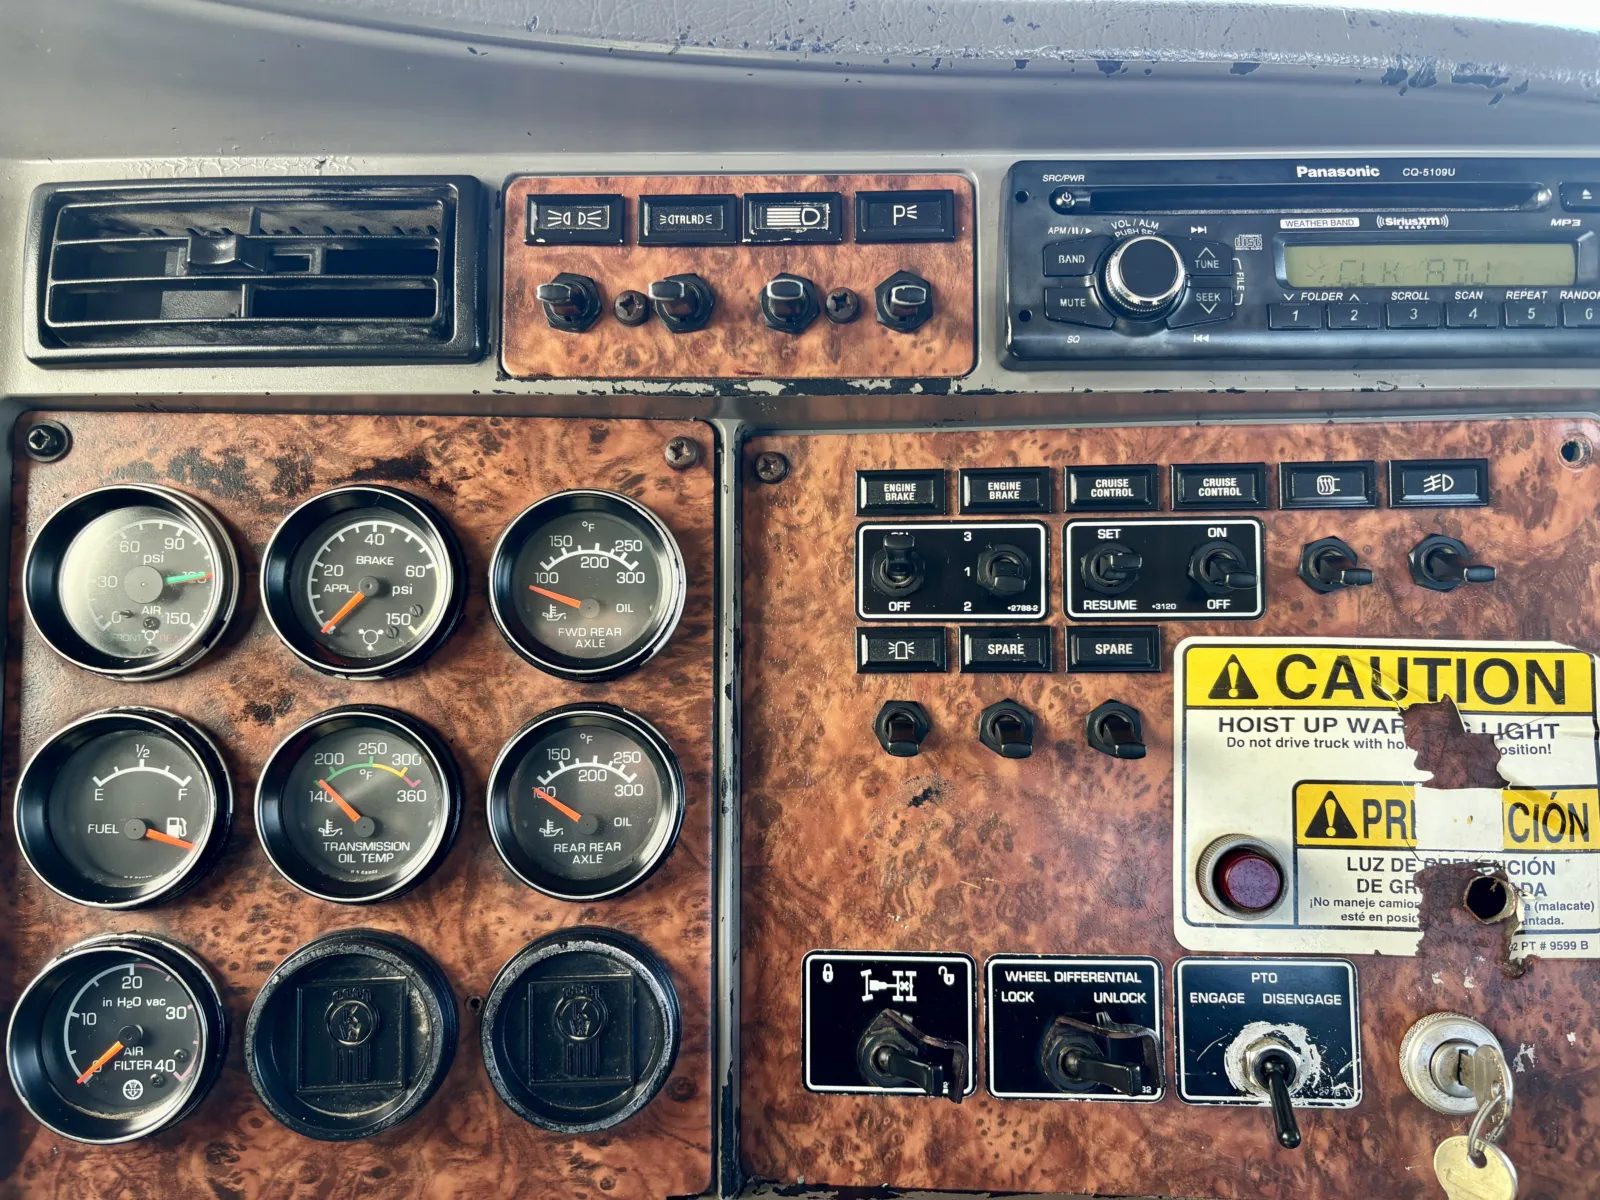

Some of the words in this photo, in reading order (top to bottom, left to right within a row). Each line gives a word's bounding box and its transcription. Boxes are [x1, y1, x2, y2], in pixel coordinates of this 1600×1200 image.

[1296, 166, 1380, 178] Panasonic
[1402, 168, 1456, 177] CQ-5109U
[1042, 174, 1085, 182] SRC/PWR
[1110, 219, 1131, 230] VOL
[1138, 219, 1160, 230] ALM
[1285, 219, 1328, 227] WEATHER
[1330, 219, 1354, 227] BAND
[1550, 218, 1582, 227] MP3
[1114, 228, 1139, 238] PUSH
[1058, 255, 1085, 264] BAND
[1195, 259, 1219, 269] TUNE
[1236, 272, 1245, 291] FILE
[1195, 293, 1221, 302] SEEK
[1300, 292, 1343, 301] FOLDER
[1391, 291, 1430, 300] SCROLL
[1454, 290, 1483, 300] SCAN
[1505, 290, 1548, 300] REPEAT
[1559, 290, 1600, 300] RANDO
[1060, 298, 1086, 307] MUTE
[1292, 310, 1299, 321] 1
[1350, 310, 1358, 321] 2
[1410, 308, 1418, 320] 3
[1468, 308, 1477, 319] 4
[1528, 308, 1536, 319] 5
[1067, 335, 1080, 344] SQ
[987, 481, 1021, 491] ENGINE
[1095, 478, 1129, 488] CRUISE
[1203, 477, 1237, 487] CRUISE
[883, 483, 917, 493] ENGINE
[1090, 488, 1134, 498] CONTROL
[1198, 487, 1242, 496] CONTROL
[885, 492, 915, 501] BRAKE
[989, 491, 1020, 500] BRAKE
[963, 532, 972, 542] 3
[1097, 529, 1122, 539] SET
[1207, 527, 1227, 538] ON
[164, 537, 185, 550] 90
[364, 533, 385, 546] 40
[548, 535, 573, 547] 150
[119, 540, 140, 553] 60
[615, 539, 643, 552] 250
[143, 551, 164, 565] psi
[355, 555, 394, 566] BRAKE
[580, 556, 610, 569] 200
[323, 564, 344, 577] 20
[405, 565, 426, 578] 60
[964, 567, 970, 577] 1
[97, 575, 118, 588] 30
[534, 572, 559, 584] 100
[616, 572, 645, 584] 300
[323, 583, 355, 594] APPL.
[392, 583, 413, 597] psi
[141, 605, 162, 615] AIR
[616, 603, 634, 613] OIL
[888, 601, 911, 612] OFF
[963, 601, 972, 611] 2
[1083, 600, 1137, 610] RESUME
[1206, 599, 1231, 610] OFF
[111, 611, 122, 623] 0
[165, 612, 191, 625] 150
[386, 613, 411, 626] 150
[558, 628, 587, 637] FWD
[590, 628, 622, 637] REAR
[575, 638, 606, 648] AXLE
[987, 643, 1025, 655] SPARE
[1095, 643, 1133, 655] SPARE
[1276, 654, 1566, 705] CAUTION
[1218, 716, 1295, 733] HOIST
[1303, 717, 1338, 733] UP
[358, 742, 388, 755] 250
[1226, 736, 1245, 748] Do
[1249, 737, 1271, 748] not
[1275, 737, 1309, 748] drive
[1314, 737, 1350, 749] truck
[1354, 737, 1382, 749] with
[1500, 743, 1552, 756] osition!
[314, 752, 345, 765] 200
[391, 753, 422, 766] 300
[546, 748, 571, 761] 150
[613, 751, 642, 764] 250
[578, 769, 608, 782] 200
[94, 788, 104, 801] E
[178, 788, 188, 801] F
[614, 784, 644, 797] 300
[396, 790, 427, 803] 360
[613, 817, 632, 827] OIL
[87, 823, 120, 834] FUEL
[323, 841, 411, 852] TRANSMISSION
[553, 843, 586, 853] REAR
[589, 842, 622, 852] REAR
[338, 853, 356, 863] OIL
[361, 853, 394, 863] TEMP
[572, 854, 604, 864] AXLE
[1347, 856, 1384, 872] LUZ
[1391, 857, 1417, 873] DE
[1357, 878, 1382, 893] DE
[1309, 896, 1330, 908] ¡No
[1333, 898, 1376, 909] maneje
[1534, 900, 1595, 912] (malacate)
[1341, 911, 1366, 922] esté
[1369, 914, 1383, 922] en
[1521, 941, 1536, 951] PT
[1540, 940, 1546, 951] #
[1550, 940, 1577, 951] 9599
[1580, 940, 1589, 950] B
[1004, 970, 1051, 983] WHEEL
[1054, 971, 1142, 983] DIFFERENTIAL
[1251, 971, 1278, 983] PTO
[121, 976, 143, 989] 20
[102, 997, 113, 1007] in
[146, 998, 167, 1007] vac
[1001, 990, 1035, 1003] LOCK
[1093, 991, 1147, 1004] UNLOCK
[1190, 992, 1245, 1004] ENGAGE
[1262, 992, 1342, 1005] DISENGAGE
[165, 1006, 187, 1020] 30
[81, 1012, 97, 1026] 10
[123, 1046, 144, 1057] AIR
[114, 1060, 152, 1071] FILTER
[154, 1059, 176, 1072] 40
